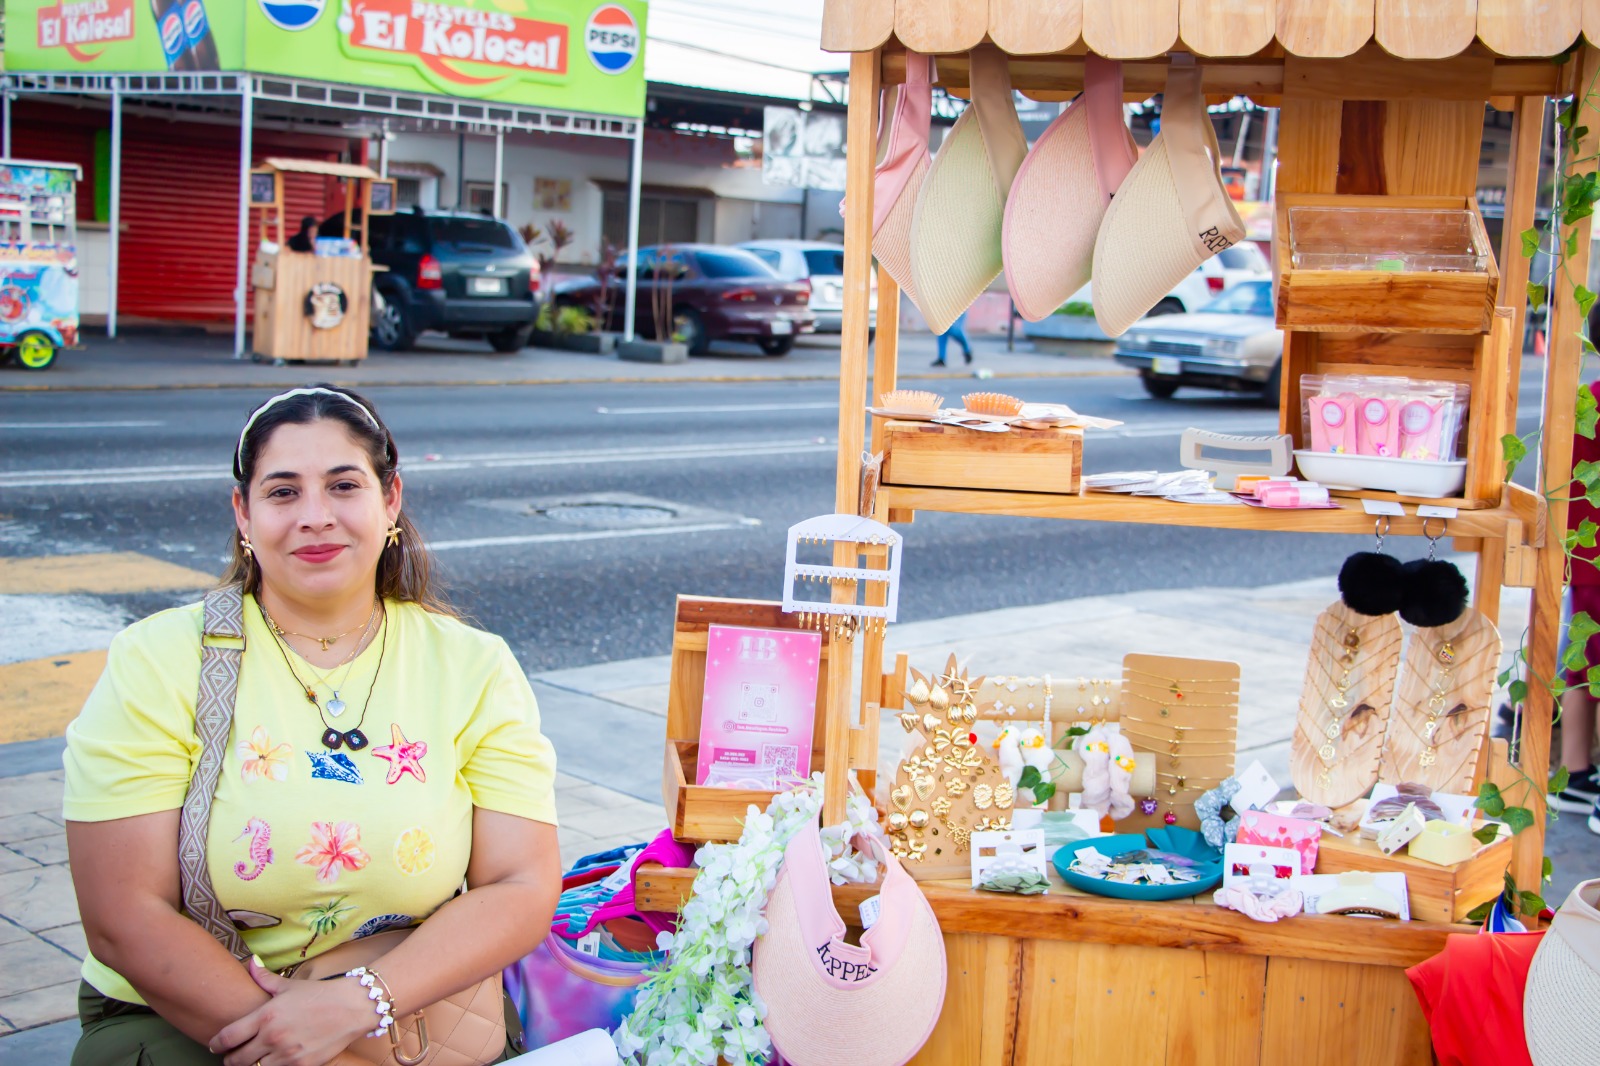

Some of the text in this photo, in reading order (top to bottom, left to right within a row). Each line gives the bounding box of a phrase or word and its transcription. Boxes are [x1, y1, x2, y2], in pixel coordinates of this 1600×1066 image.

[411, 1, 516, 32] PASTELES
[360, 10, 561, 70] El Kolosal
[589, 28, 636, 48] PEPSI
